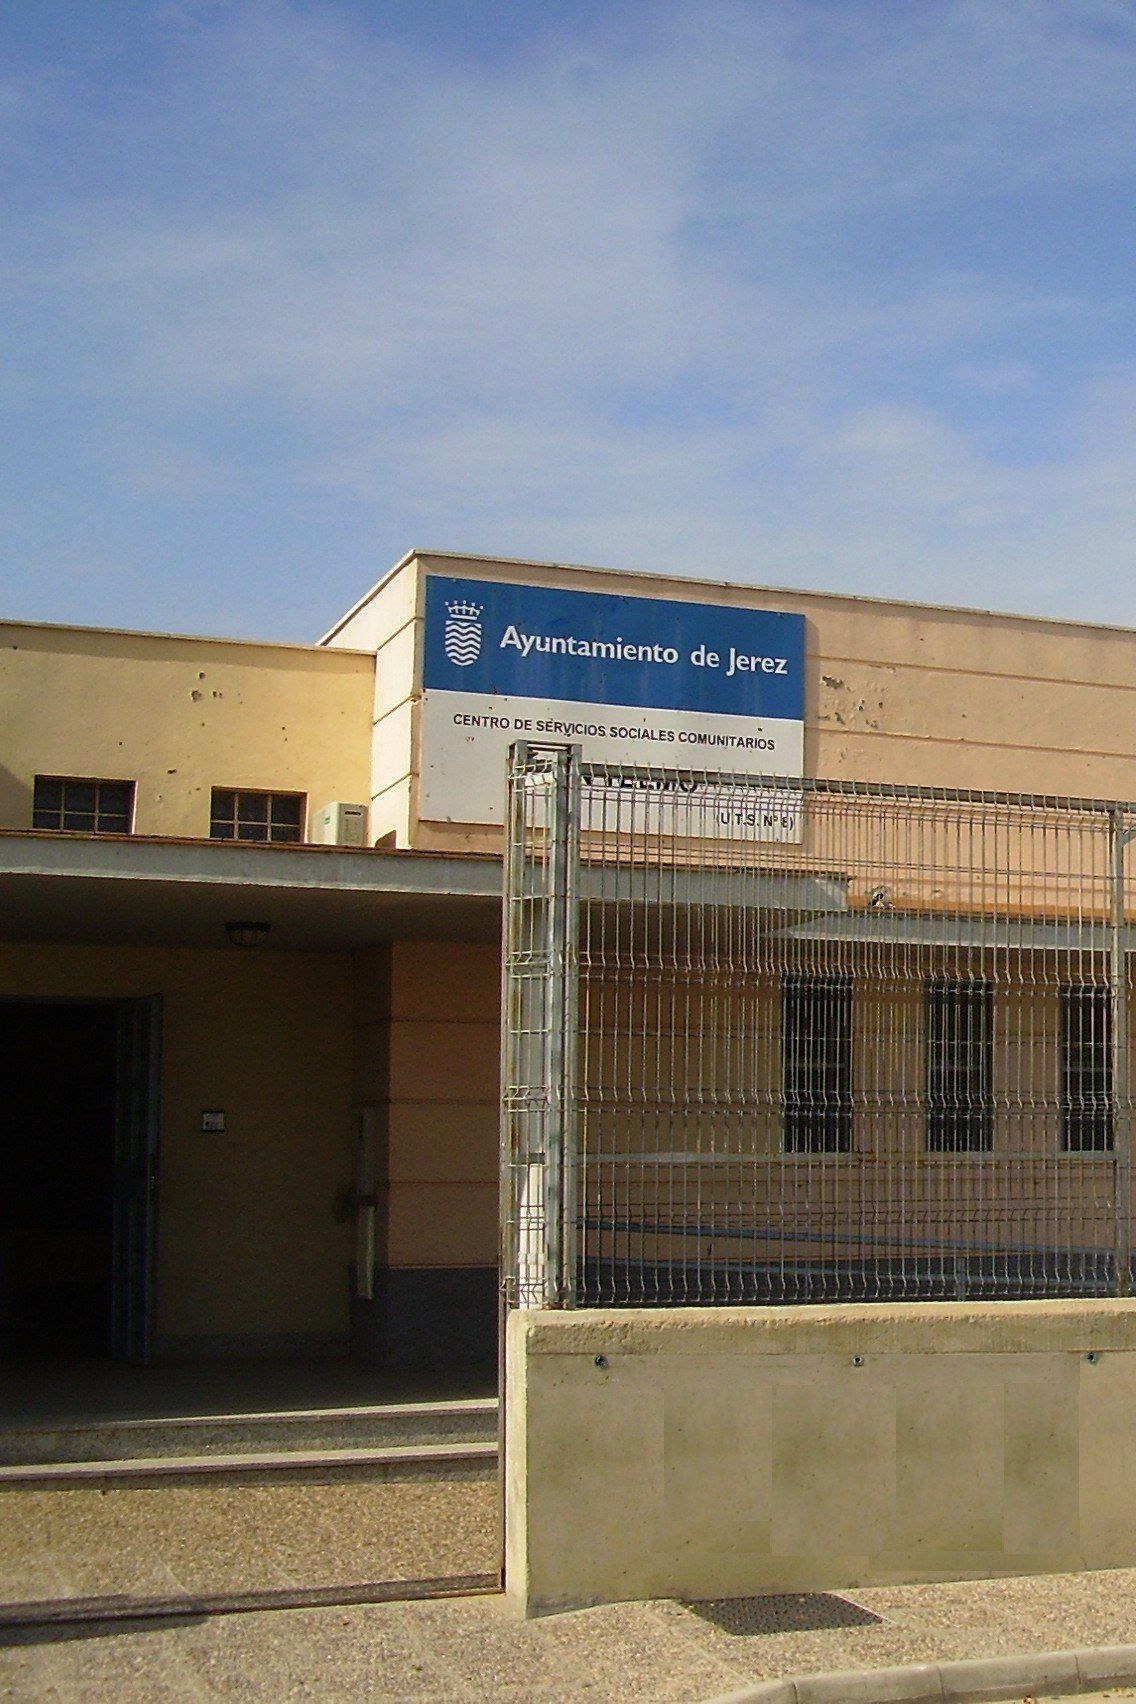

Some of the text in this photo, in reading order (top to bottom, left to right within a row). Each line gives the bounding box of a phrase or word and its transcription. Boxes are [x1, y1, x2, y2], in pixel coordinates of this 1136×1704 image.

[500, 625, 788, 676] Ayuntamiento de Jerez
[453, 713, 775, 750] CENTRO DE SERVICIOS SOCIALES COMUNITARIOS
